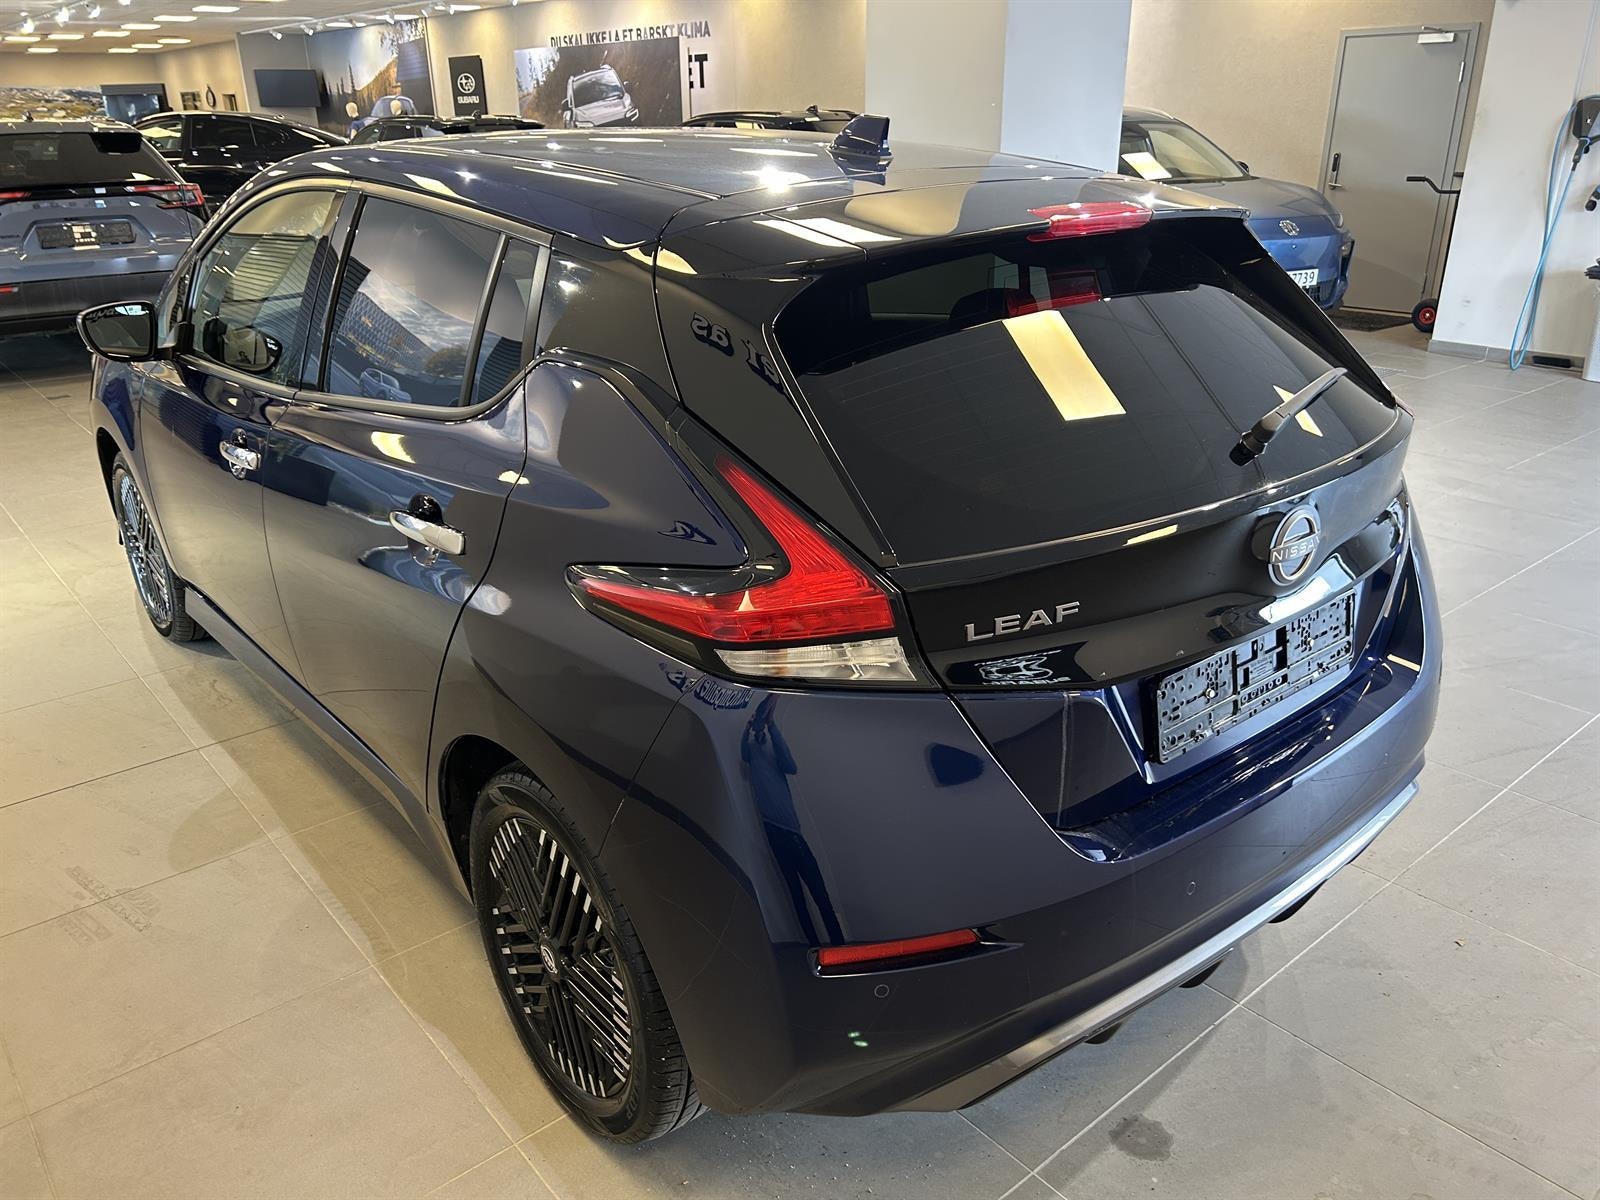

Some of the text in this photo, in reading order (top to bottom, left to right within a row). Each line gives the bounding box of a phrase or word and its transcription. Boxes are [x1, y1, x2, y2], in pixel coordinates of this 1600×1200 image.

[678, 21, 711, 38] KLIMA
[457, 95, 480, 104] SUBARU
[1288, 271, 1315, 284] 7739
[965, 601, 1080, 642] LEAF
